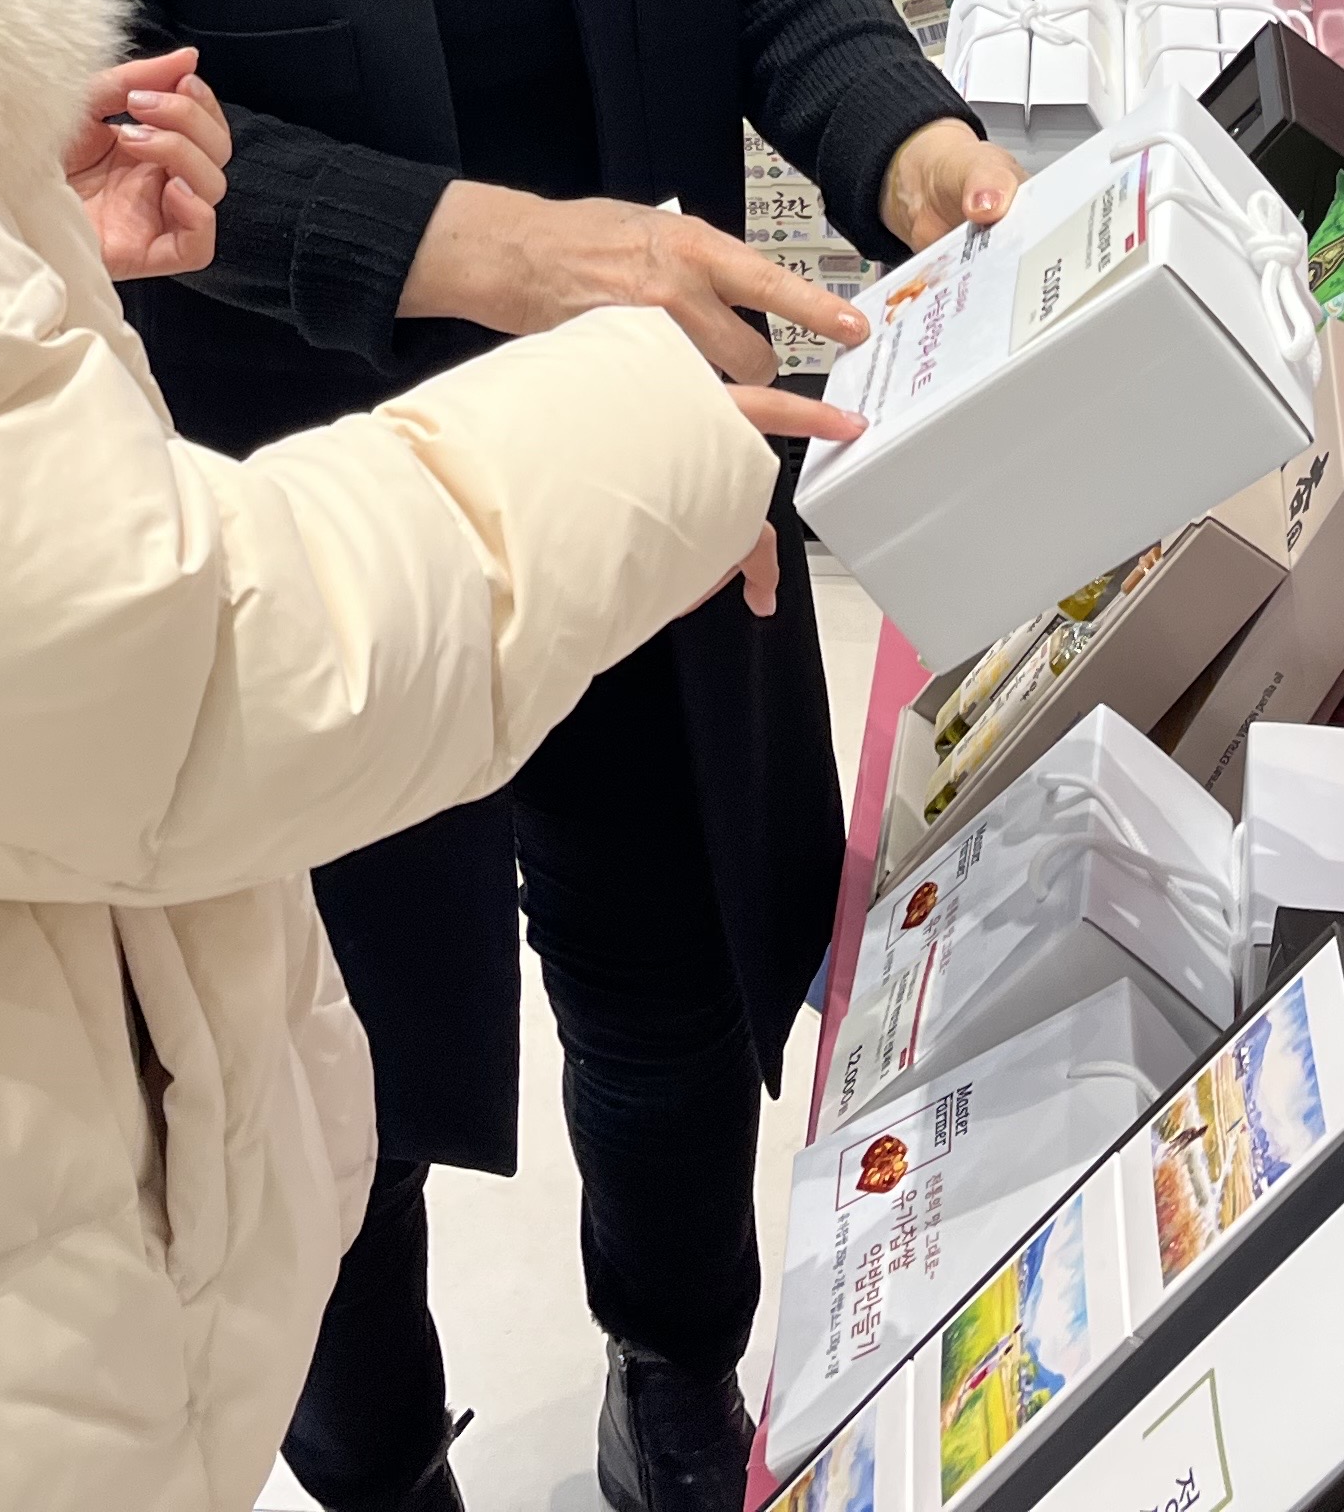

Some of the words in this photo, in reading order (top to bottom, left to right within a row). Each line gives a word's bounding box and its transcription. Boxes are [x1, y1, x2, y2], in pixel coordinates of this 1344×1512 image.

[771, 191, 812, 219] 초란
[935, 1092, 953, 1146] Farmer
[949, 1083, 972, 1142] Master
[925, 1173, 943, 1212] 전통의
[887, 1189, 918, 1275] 유가찹쌀
[852, 1242, 884, 1360] 약밥만들기
